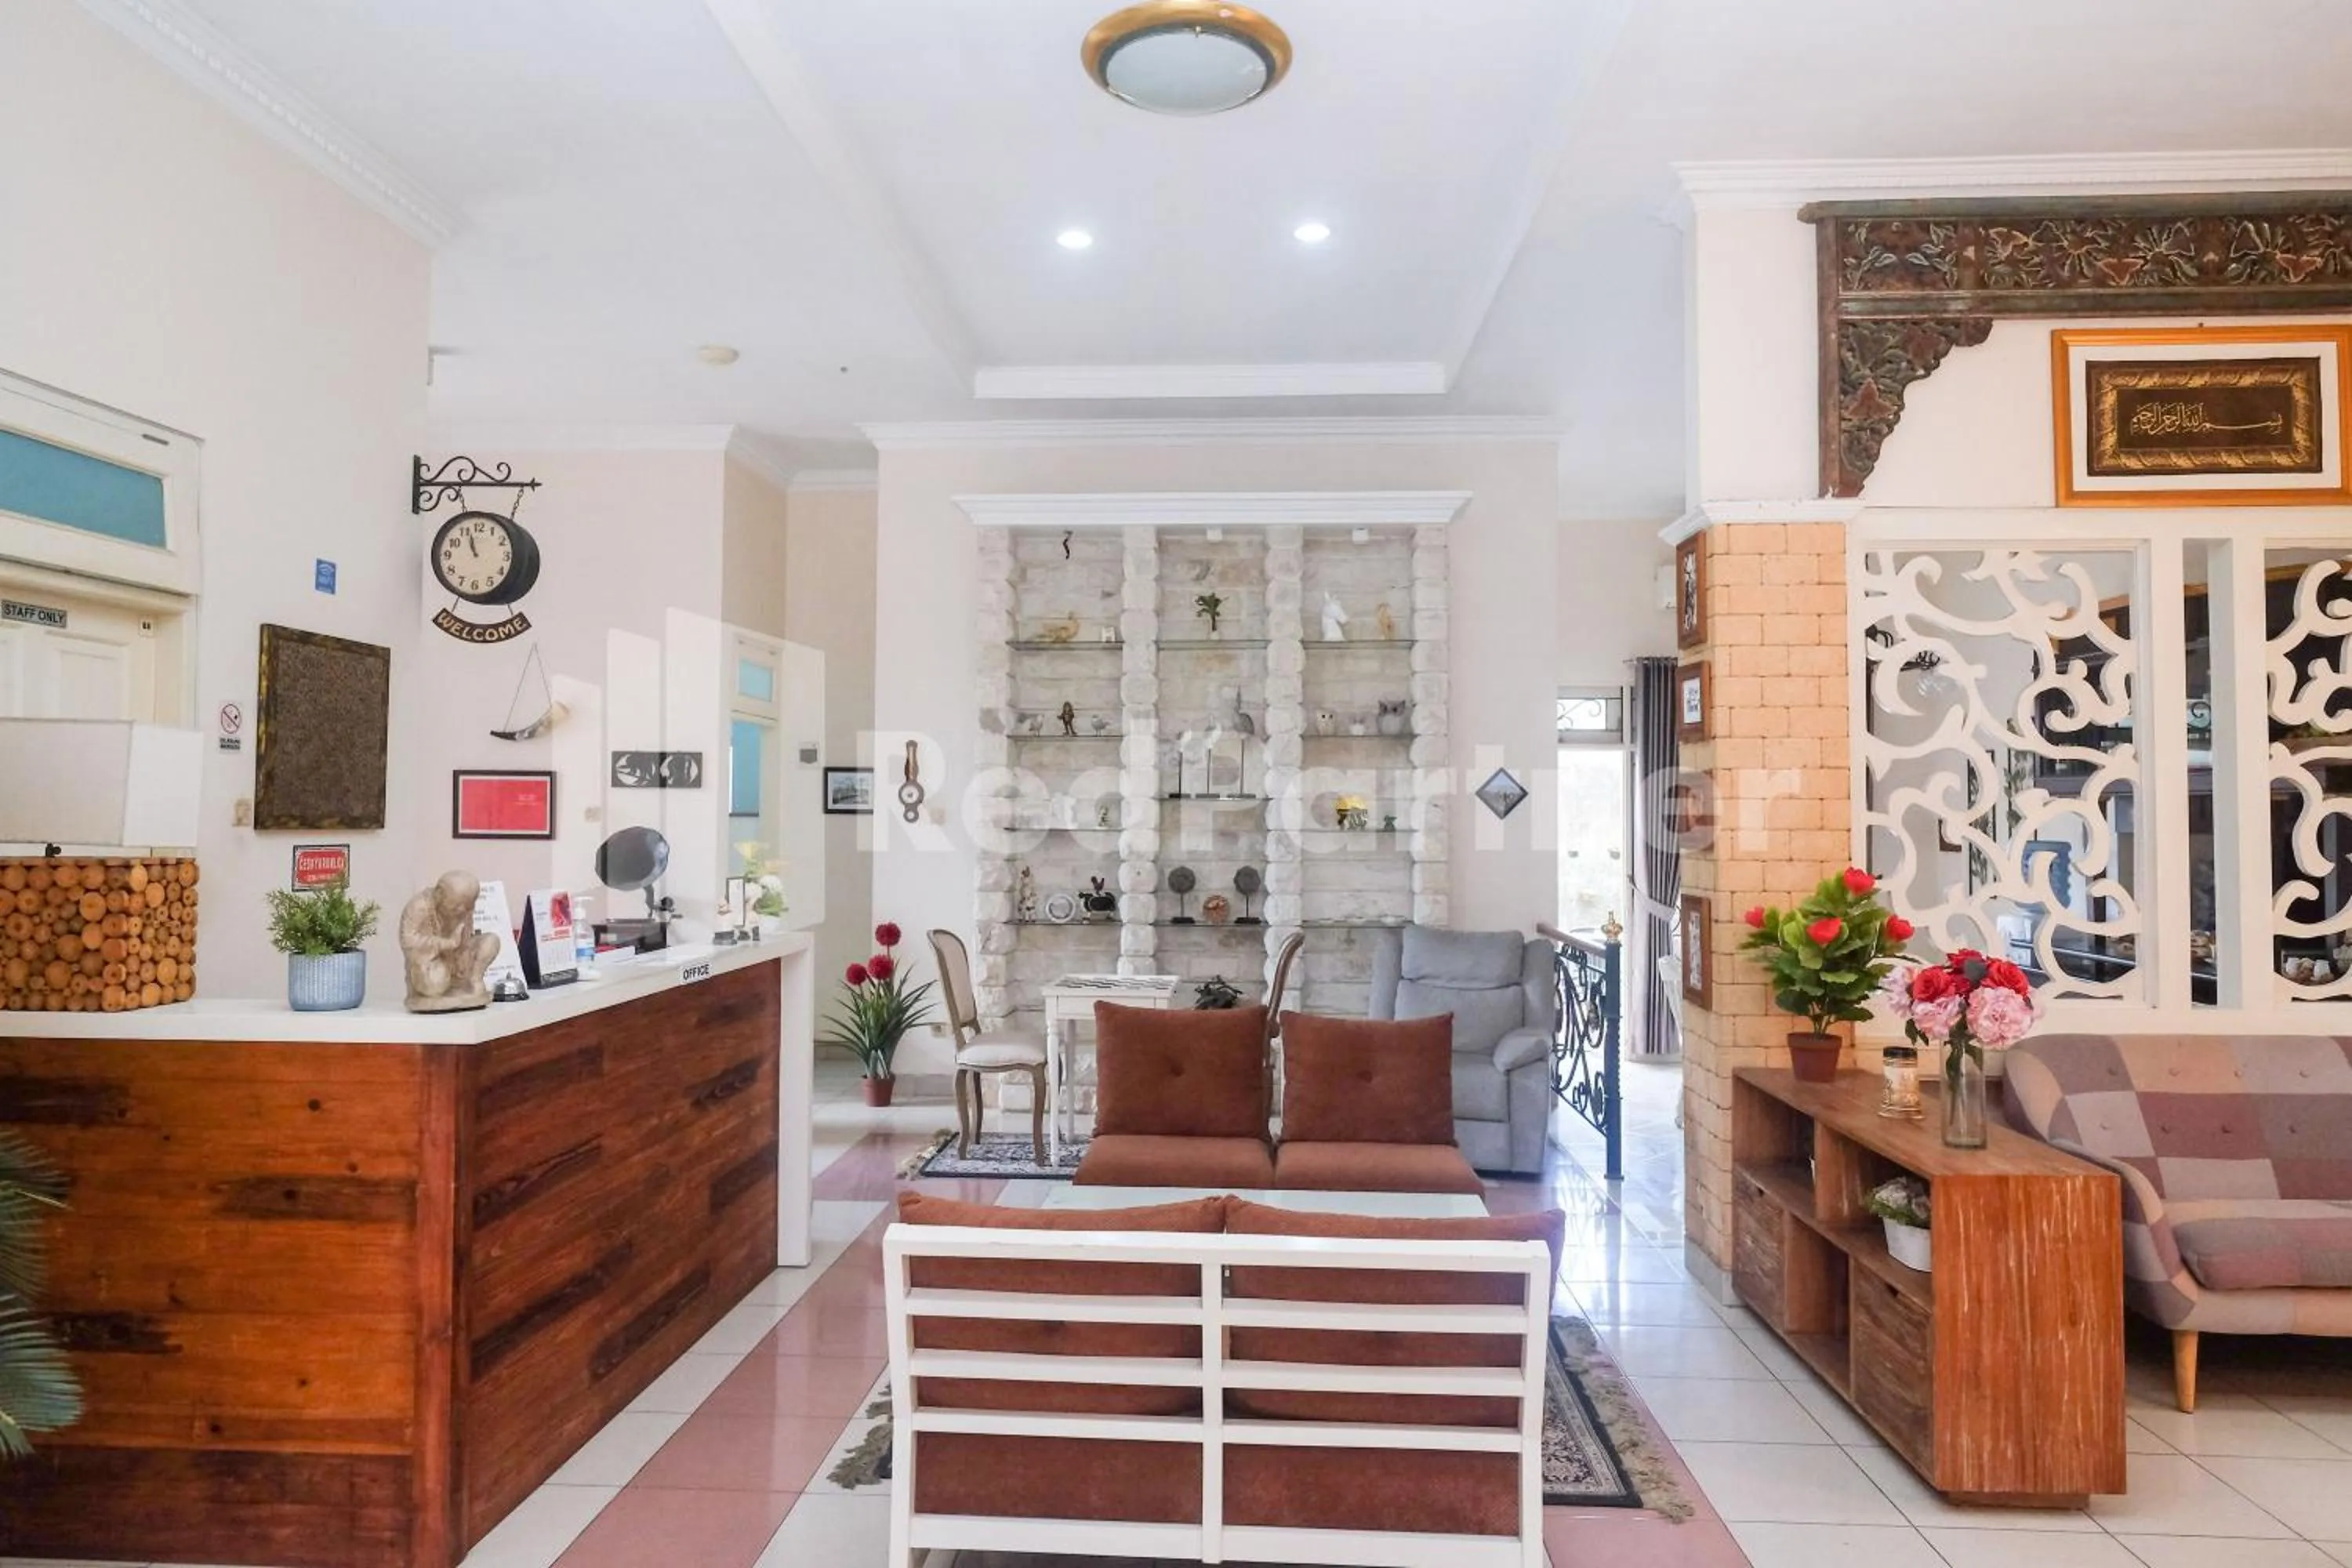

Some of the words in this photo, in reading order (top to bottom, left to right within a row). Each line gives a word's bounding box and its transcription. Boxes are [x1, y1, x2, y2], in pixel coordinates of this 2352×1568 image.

[459, 527, 470, 536] 11
[474, 522, 485, 533] 12
[490, 527, 495, 536] 1
[449, 537, 461, 548] 10
[499, 536, 506, 546] 2
[444, 550, 452, 561] 9
[503, 551, 510, 562] 3
[447, 564, 456, 576] 8
[496, 566, 504, 575] 4
[458, 575, 466, 586] 7
[470, 579, 479, 590] 6
[485, 576, 495, 587] 5
[4, 603, 37, 619] STAFF
[37, 608, 64, 623] ONLY
[437, 612, 527, 642] WELCOME
[683, 963, 710, 980] OFFICE
